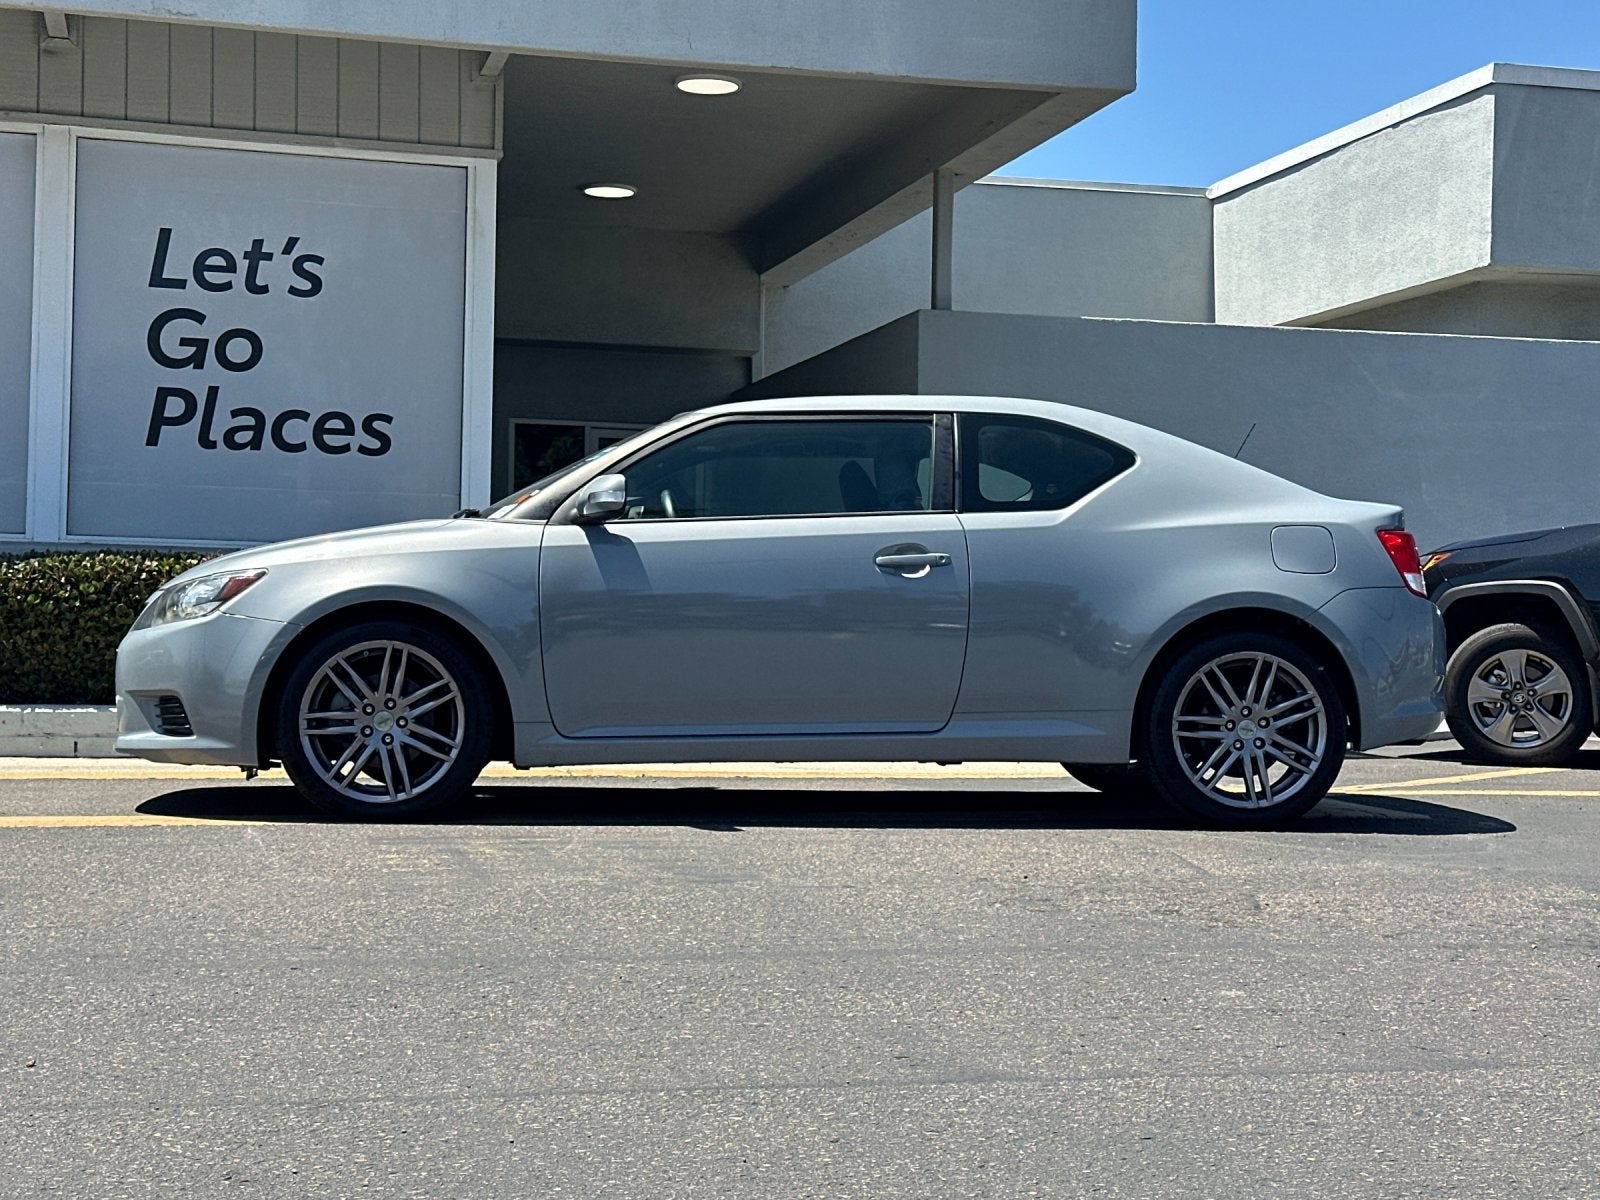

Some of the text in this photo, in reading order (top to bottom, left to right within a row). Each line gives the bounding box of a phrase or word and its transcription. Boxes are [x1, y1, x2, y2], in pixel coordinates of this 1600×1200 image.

[148, 228, 325, 299] Let's
[146, 307, 264, 373] Go
[145, 385, 394, 457] Places
